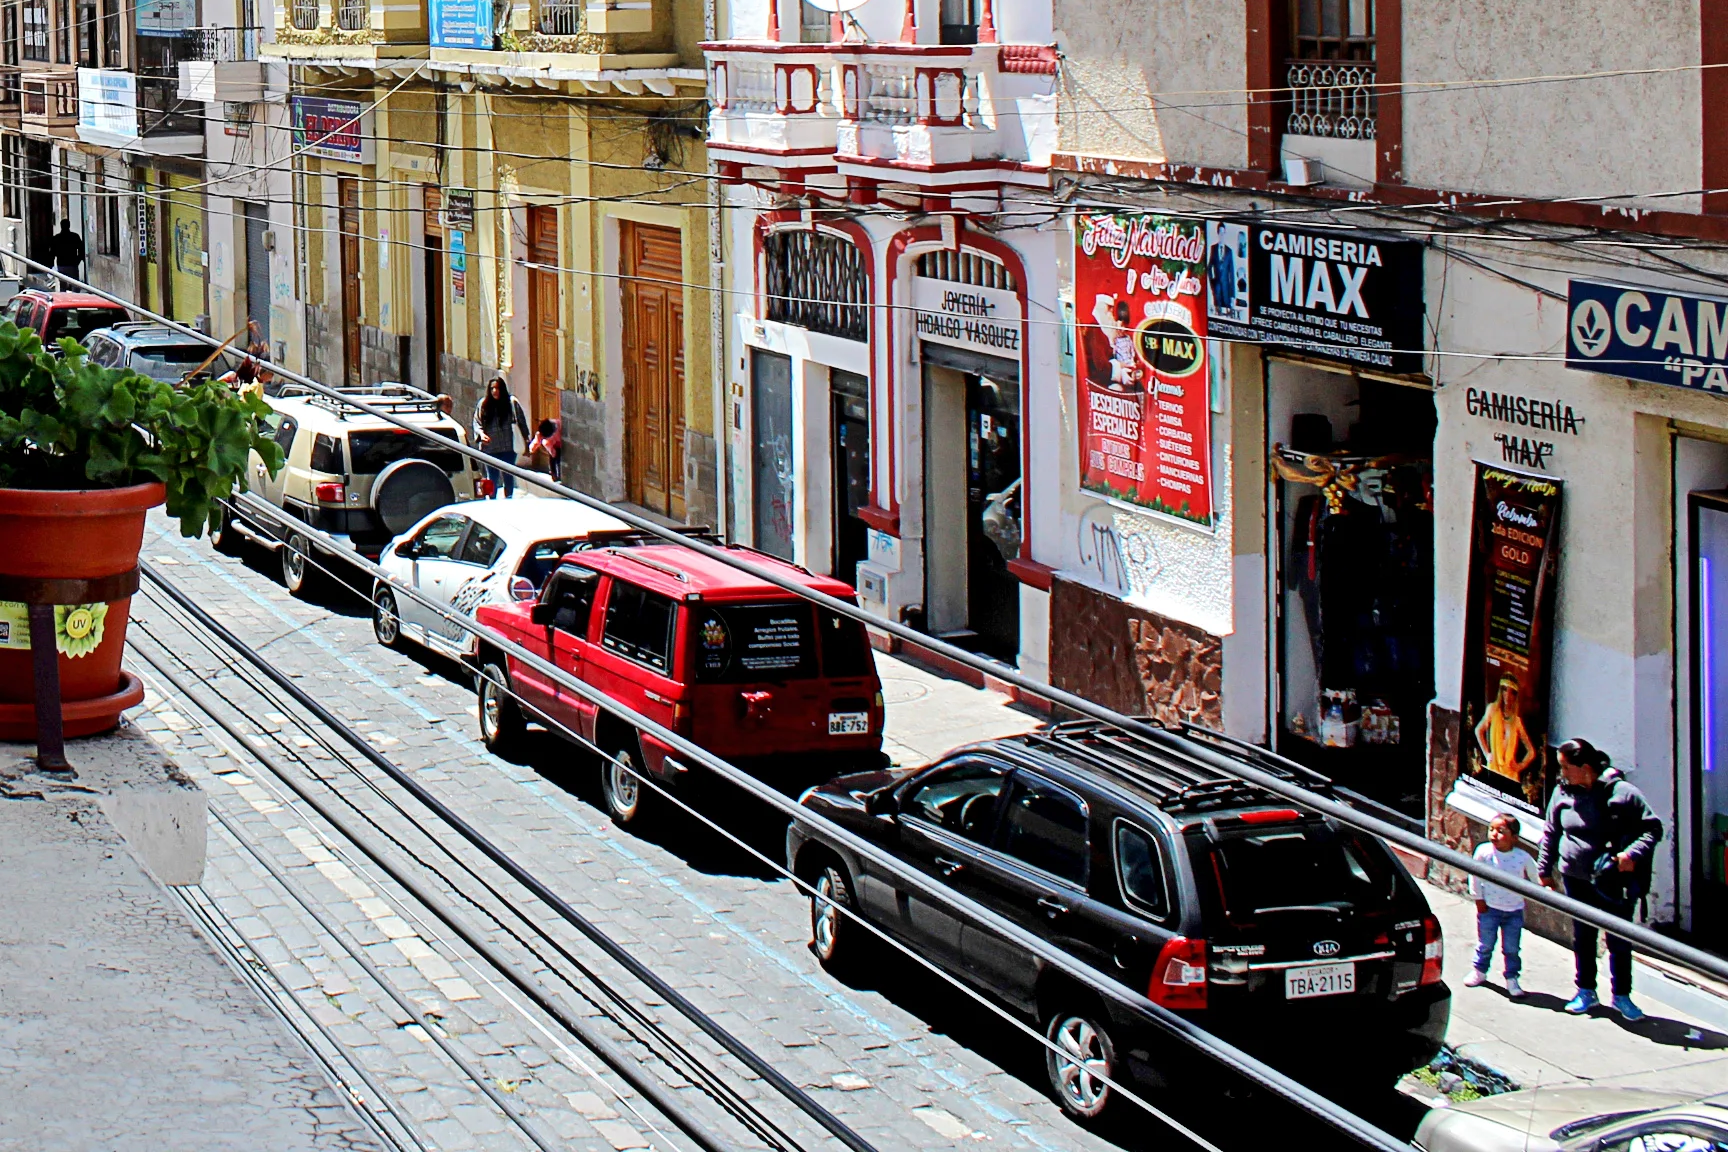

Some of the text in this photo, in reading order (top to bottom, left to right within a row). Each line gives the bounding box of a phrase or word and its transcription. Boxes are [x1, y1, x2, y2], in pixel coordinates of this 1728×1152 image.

[306, 114, 318, 143] EL
[1082, 215, 1204, 268] Feliz Navidad
[1260, 230, 1383, 267] CAMISERIA
[1270, 253, 1370, 319] MAX
[942, 290, 988, 317] JOYERÍA
[916, 311, 1019, 350] HIDALGO VÁSQUEZ
[1259, 305, 1383, 337] SE PROYECTA AL RITMO QUE TU NECESITAS
[1251, 316, 1393, 351] OFRECE CAMISAS PARA EL CABALLERO ELEGANTE
[1163, 337, 1194, 360] MAX
[1091, 391, 1141, 420] DESCUENTOS
[1158, 400, 1184, 414] TERNOS
[1466, 387, 1579, 436] CAMISERÍA
[1093, 412, 1138, 440] ESPECIALES
[1159, 413, 1183, 427] CAMISA
[1159, 426, 1192, 442] CORBATAS
[1108, 455, 1145, 481] COMPRAS
[1160, 452, 1200, 470] CINTURONES
[1160, 464, 1204, 485] MANCUERNAS
[1161, 477, 1191, 495] CHOMPAS
[1508, 527, 1544, 549] EDICION
[1501, 545, 1530, 565] GOLD
[72, 619, 87, 629] UV
[1307, 966, 1334, 976] ECUADOR
[1290, 973, 1353, 995] TBA-2115
